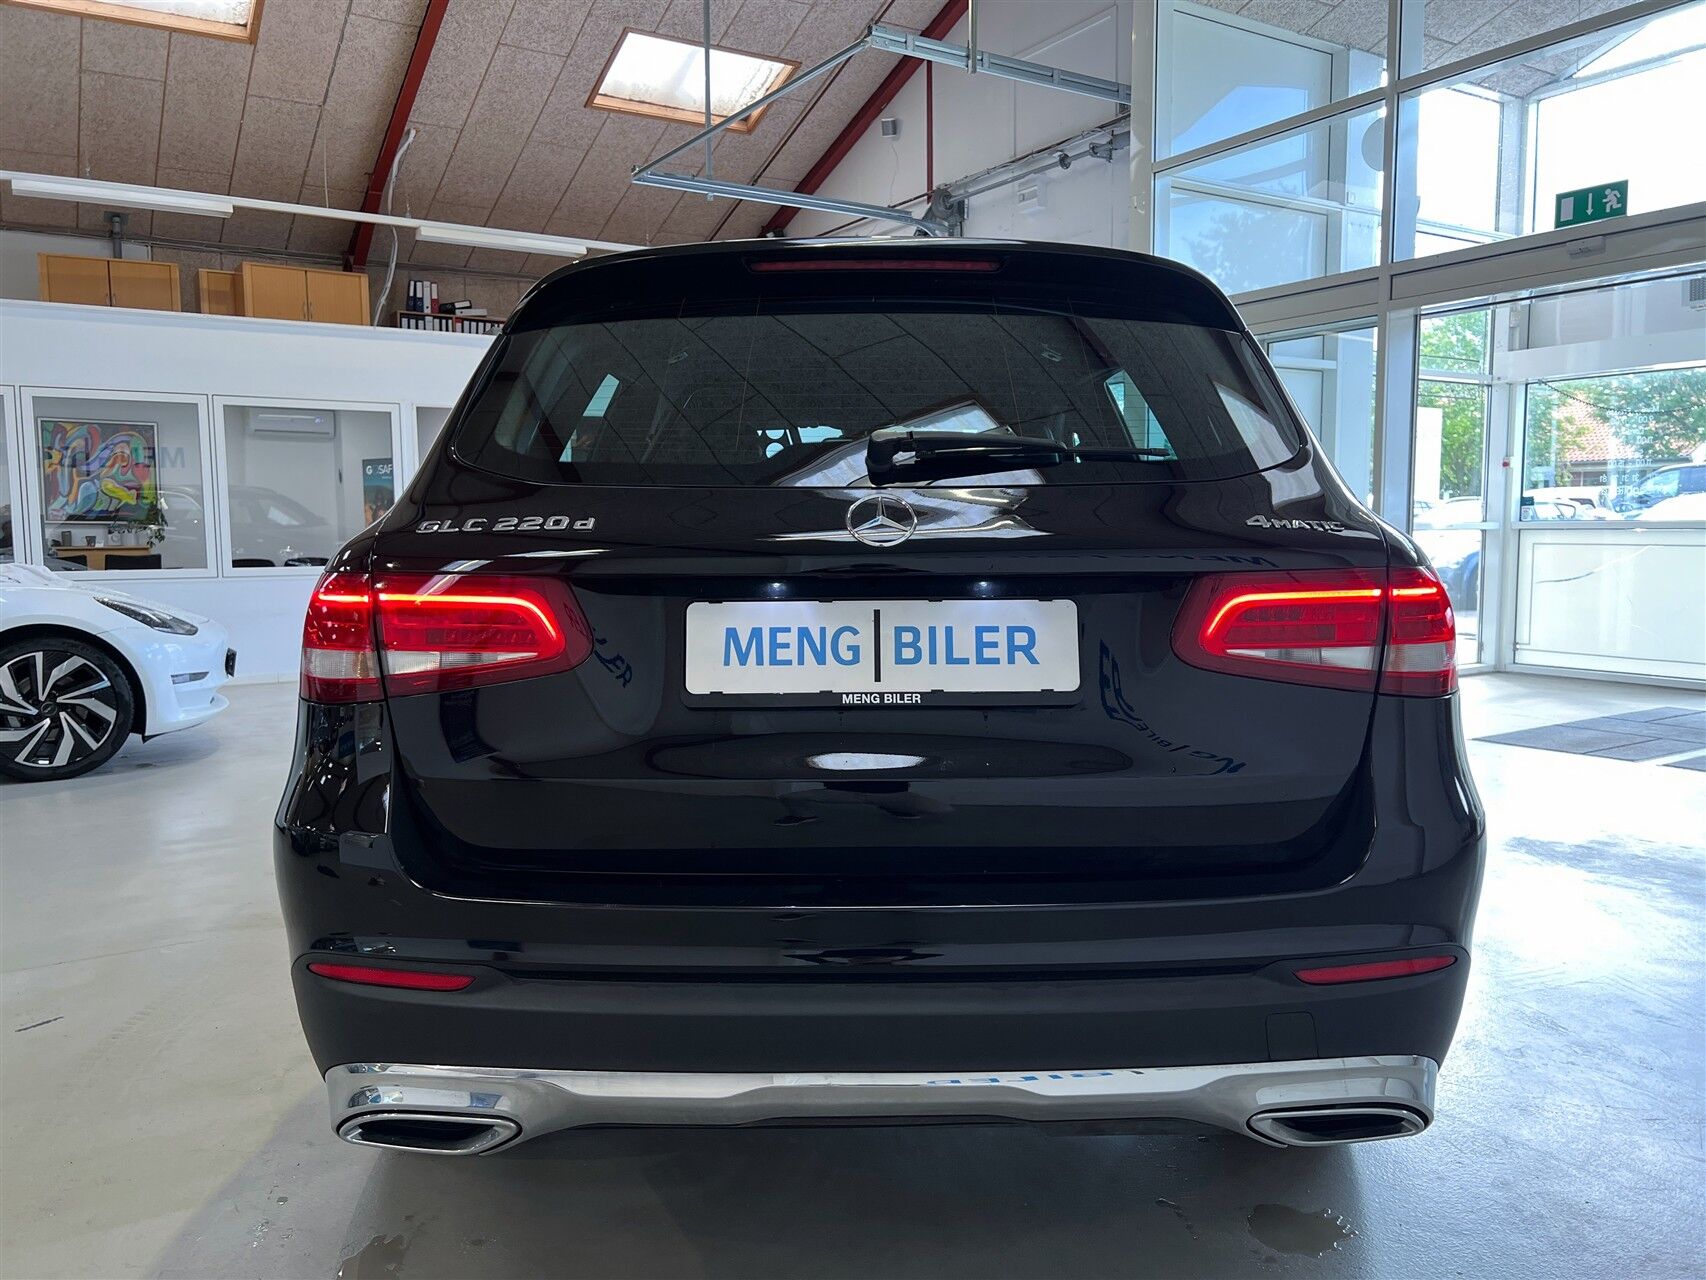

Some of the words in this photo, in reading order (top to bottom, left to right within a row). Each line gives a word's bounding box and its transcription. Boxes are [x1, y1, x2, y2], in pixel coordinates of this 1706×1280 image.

[415, 518, 488, 533] GLC
[1245, 514, 1345, 532] 4MATIC
[722, 626, 862, 667] MENG
[893, 625, 1041, 665] BILER
[842, 693, 880, 704] MENG
[884, 693, 921, 704] BILER
